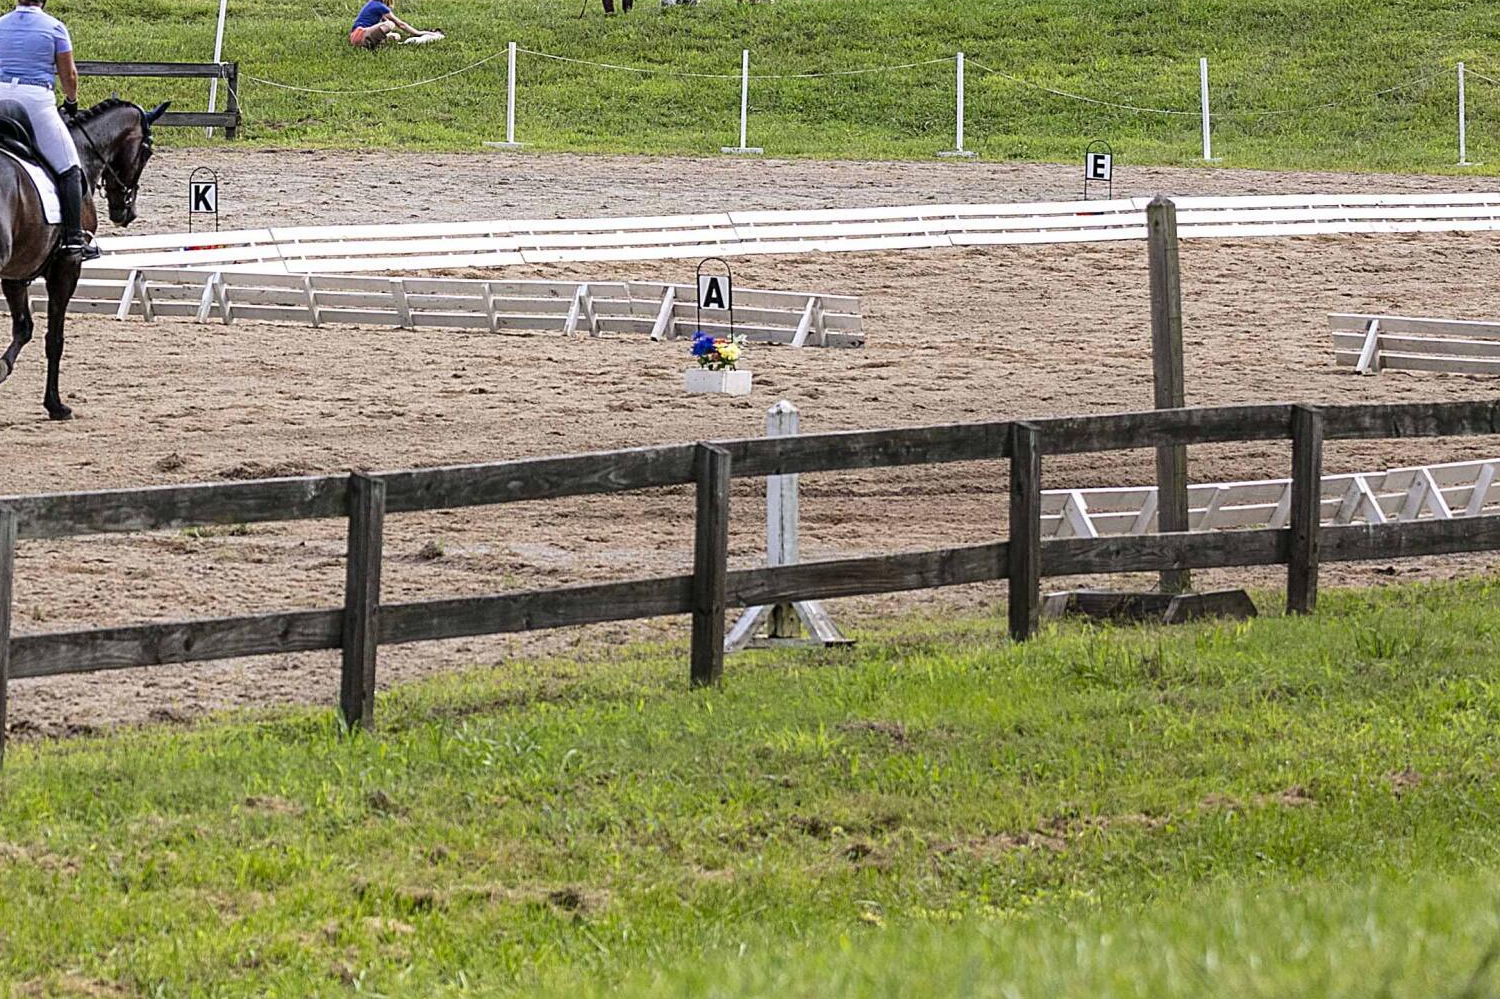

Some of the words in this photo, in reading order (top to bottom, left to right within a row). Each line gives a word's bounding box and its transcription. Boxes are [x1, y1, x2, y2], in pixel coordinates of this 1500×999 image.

[1093, 154, 1105, 178] E
[194, 184, 213, 211] K
[703, 277, 725, 309] A
